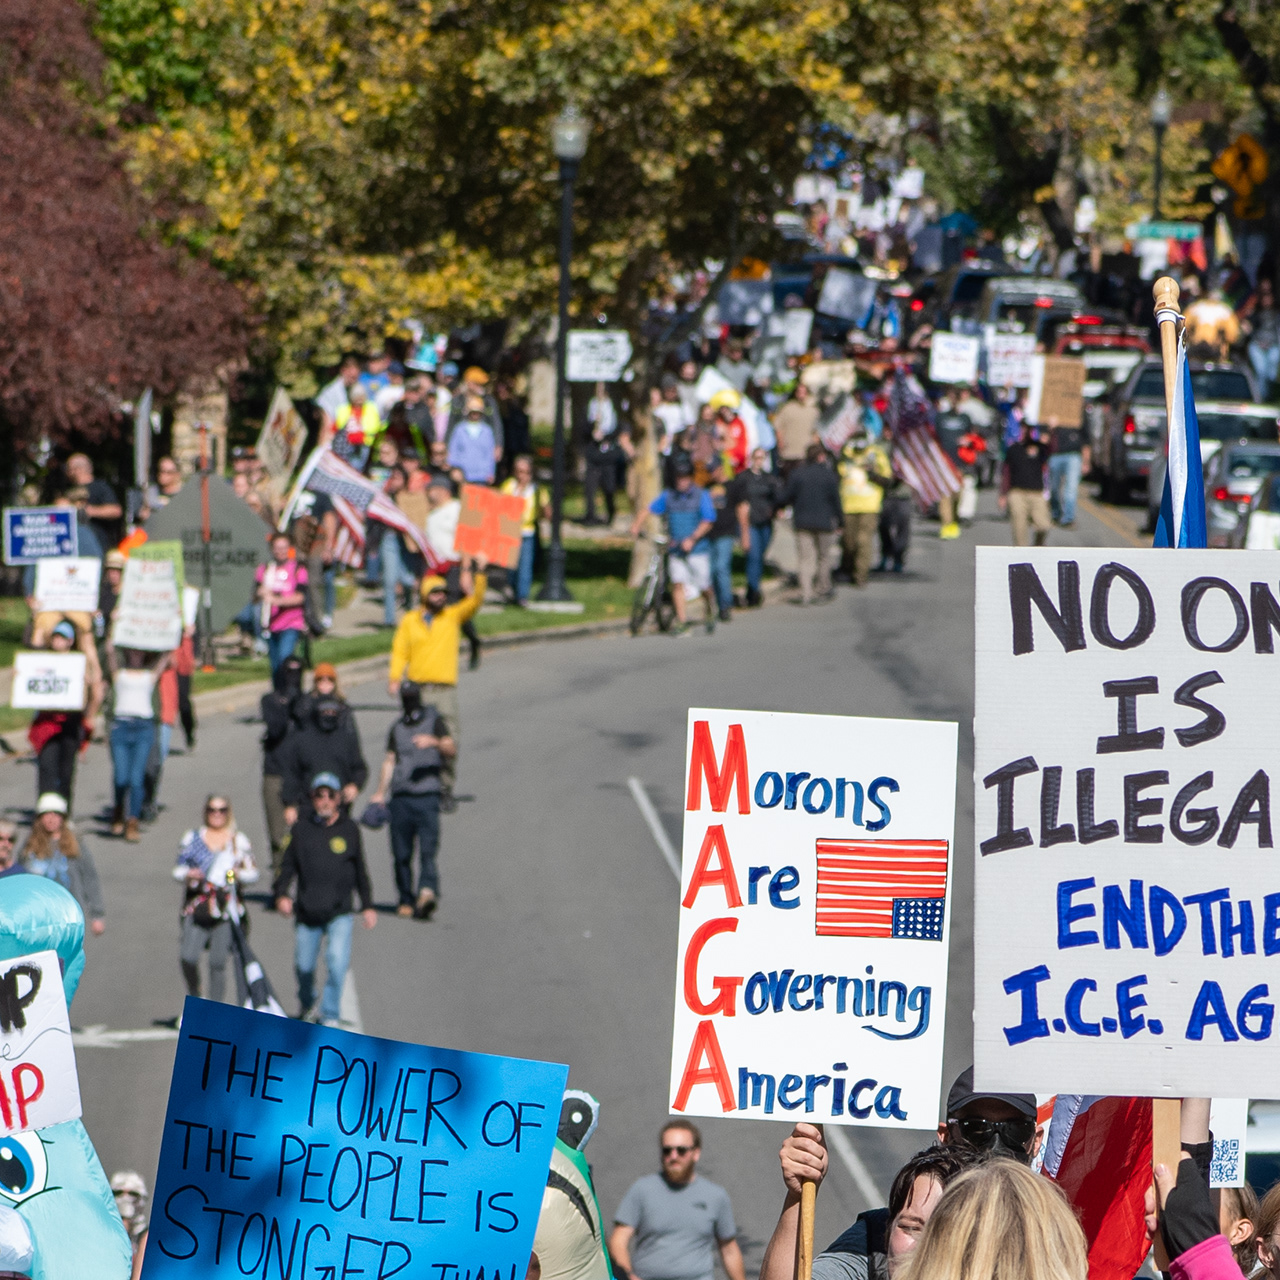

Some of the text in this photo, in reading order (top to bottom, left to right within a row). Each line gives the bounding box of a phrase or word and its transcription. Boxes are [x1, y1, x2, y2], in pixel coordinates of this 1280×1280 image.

[1008, 560, 1156, 655] NO
[1096, 670, 1227, 754] IS
[686, 720, 900, 832] Morons
[682, 824, 801, 910] Are
[683, 917, 932, 1041] Governing
[1002, 964, 1164, 1046] I.C.E.
[188, 1034, 545, 1153] THE POWER OF
[671, 1020, 908, 1121] America
[173, 1118, 519, 1234] THE PEOPLE IS
